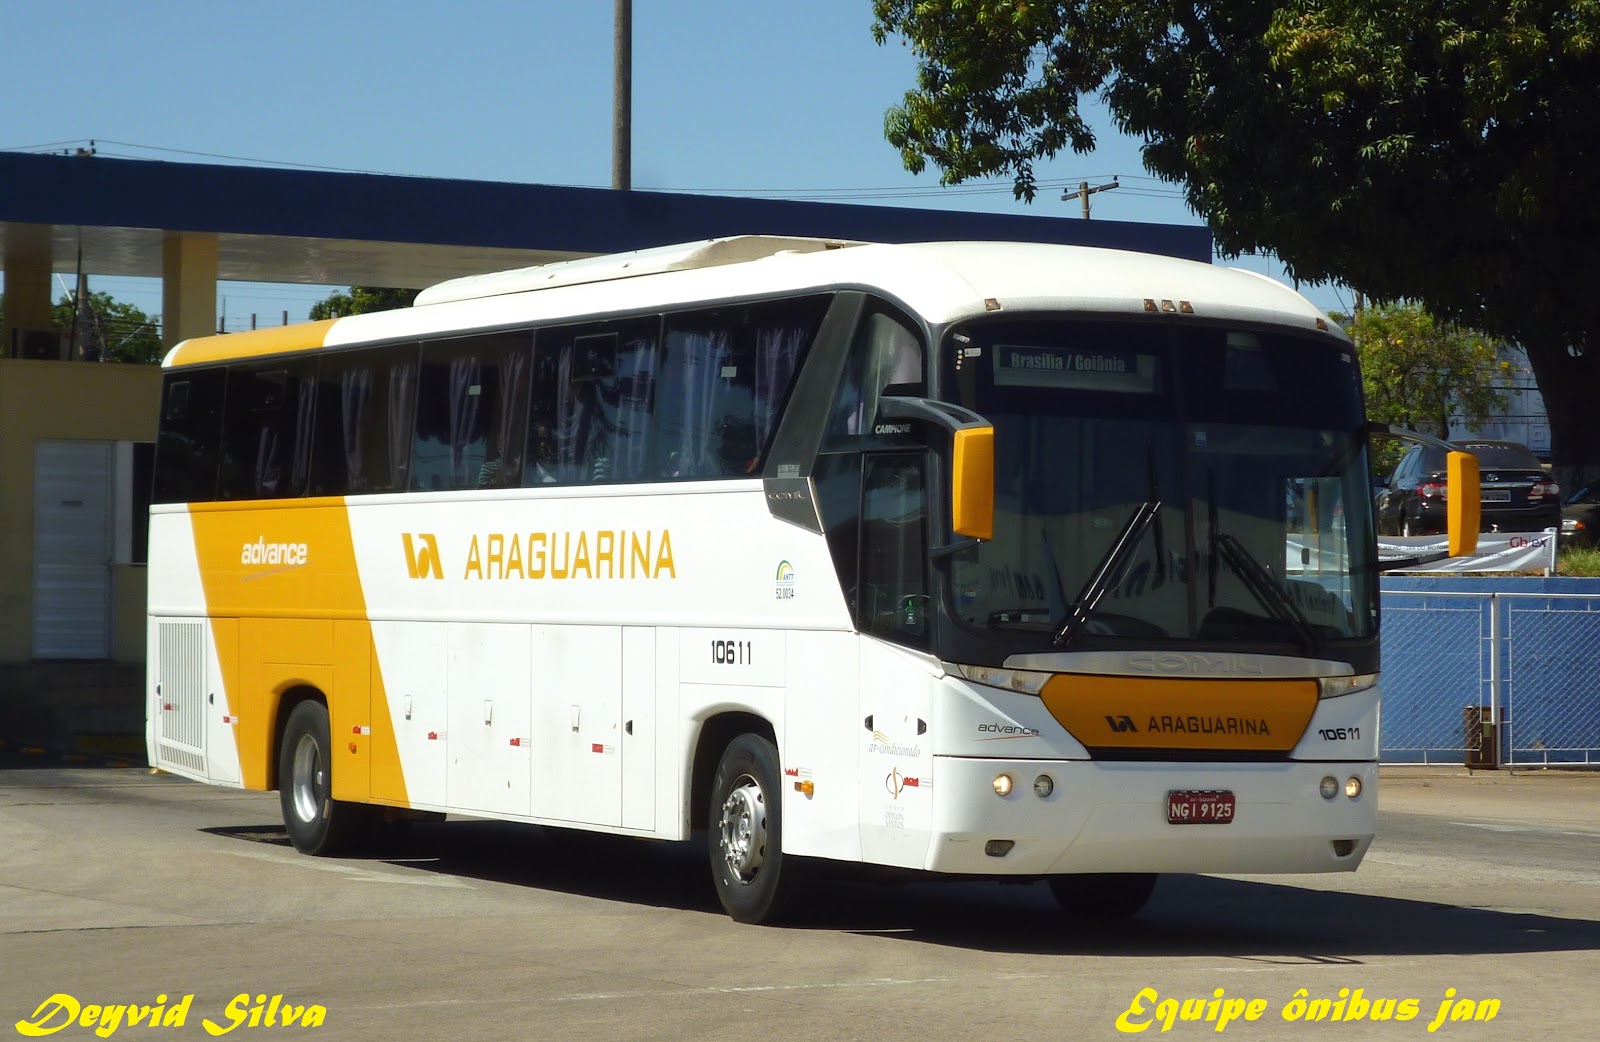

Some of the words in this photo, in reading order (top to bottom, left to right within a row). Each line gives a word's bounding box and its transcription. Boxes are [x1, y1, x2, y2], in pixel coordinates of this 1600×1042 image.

[1011, 352, 1063, 370] Brasília
[1075, 354, 1126, 372] Goiânia
[875, 424, 911, 434] CAMPIONE
[241, 536, 308, 565] advance
[465, 529, 677, 580] ARAGUARINA
[711, 640, 751, 665] 10611
[978, 722, 1040, 736] advance
[1147, 715, 1271, 736] ARAGUARINA
[1318, 727, 1361, 741] 10611
[1201, 803, 1232, 817] 9125
